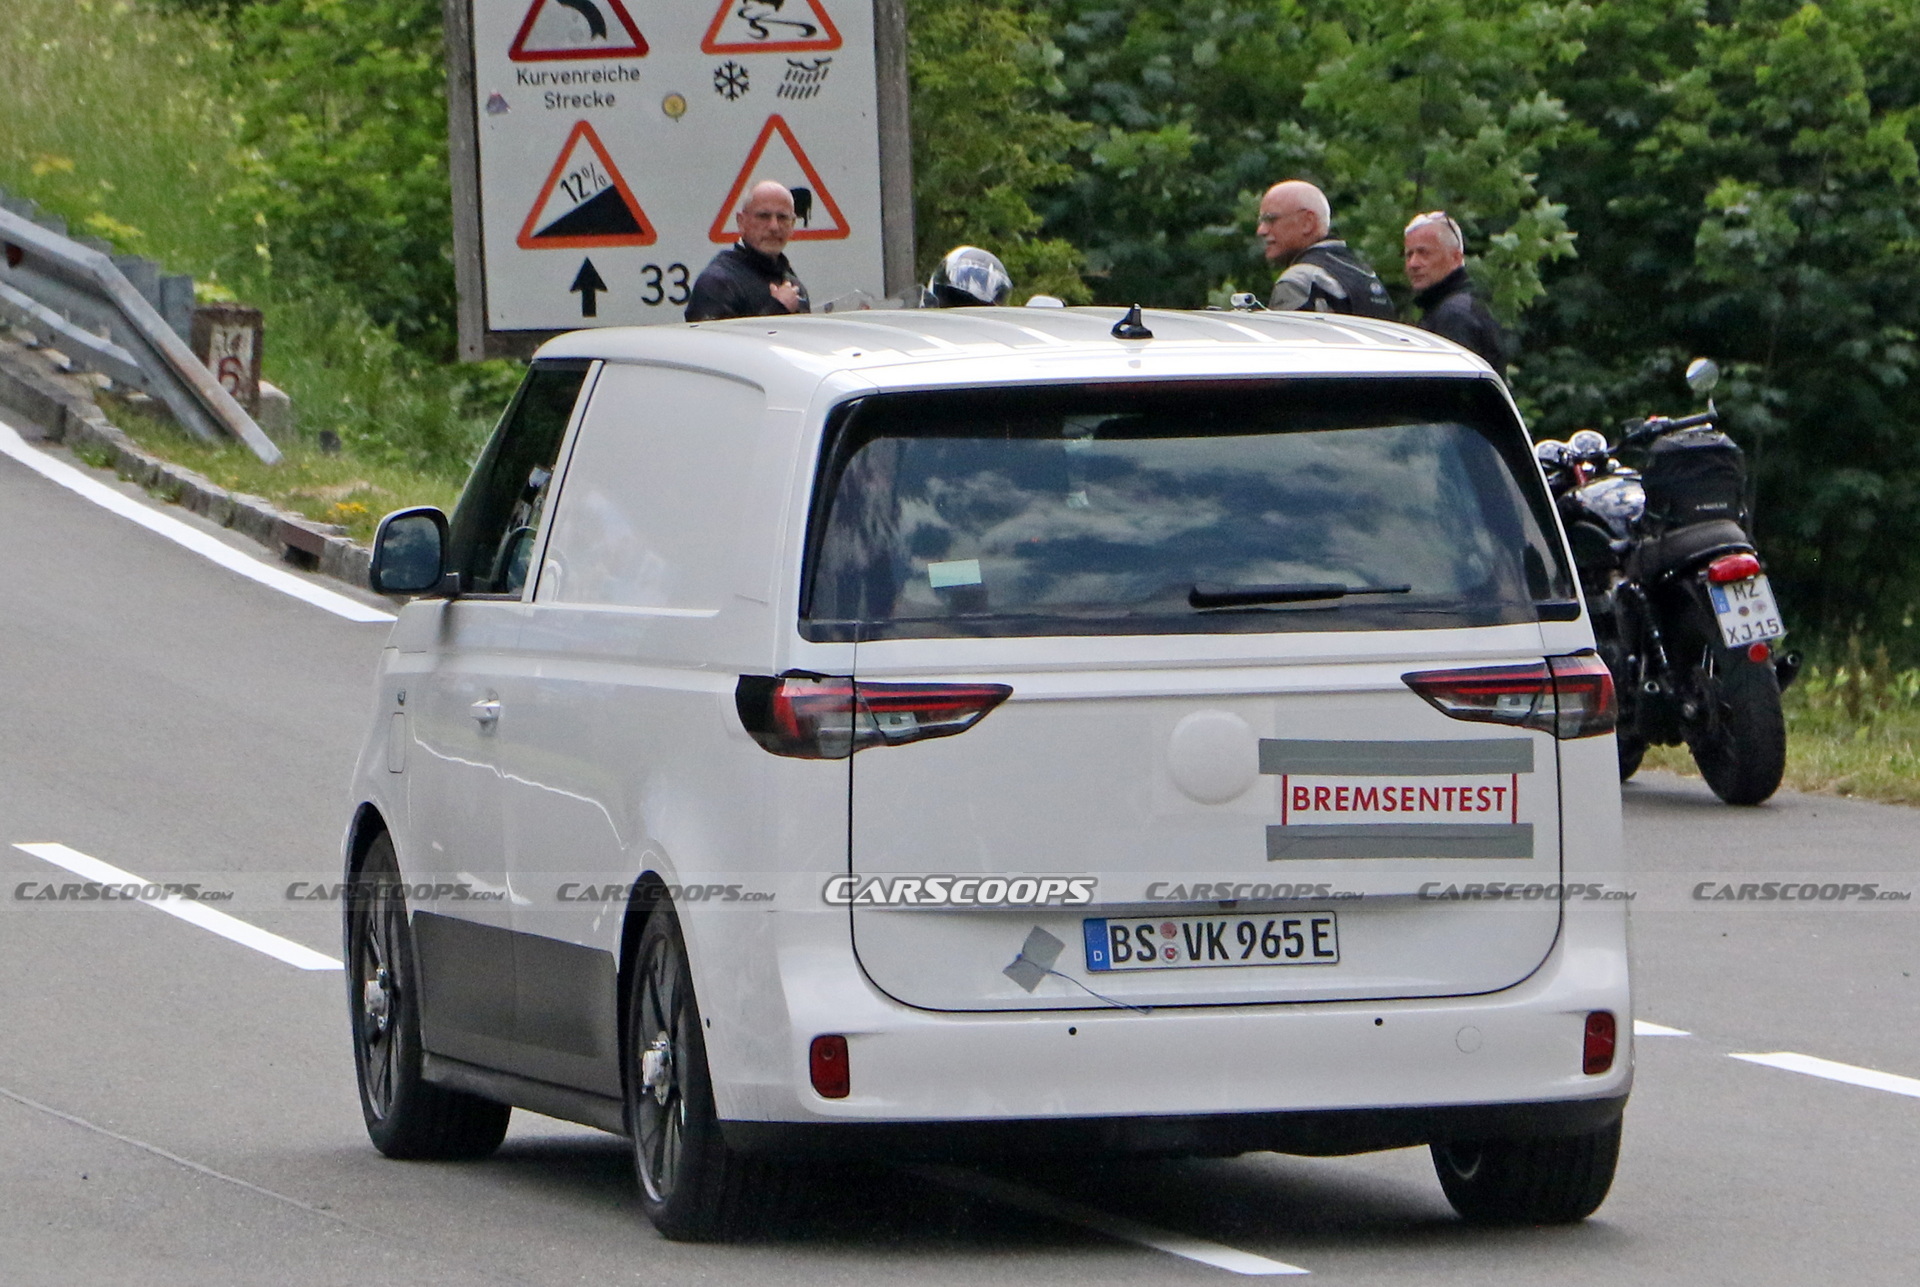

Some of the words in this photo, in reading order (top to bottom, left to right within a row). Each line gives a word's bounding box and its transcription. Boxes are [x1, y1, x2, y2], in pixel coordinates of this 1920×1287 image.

[517, 66, 640, 86] Kurvenreiche
[544, 91, 615, 110] Strecke
[561, 162, 606, 204] 12%
[641, 262, 691, 306] 33
[1293, 786, 1507, 812] BREMSENTEST
[1093, 951, 1103, 962] D
[1110, 924, 1157, 963] BS
